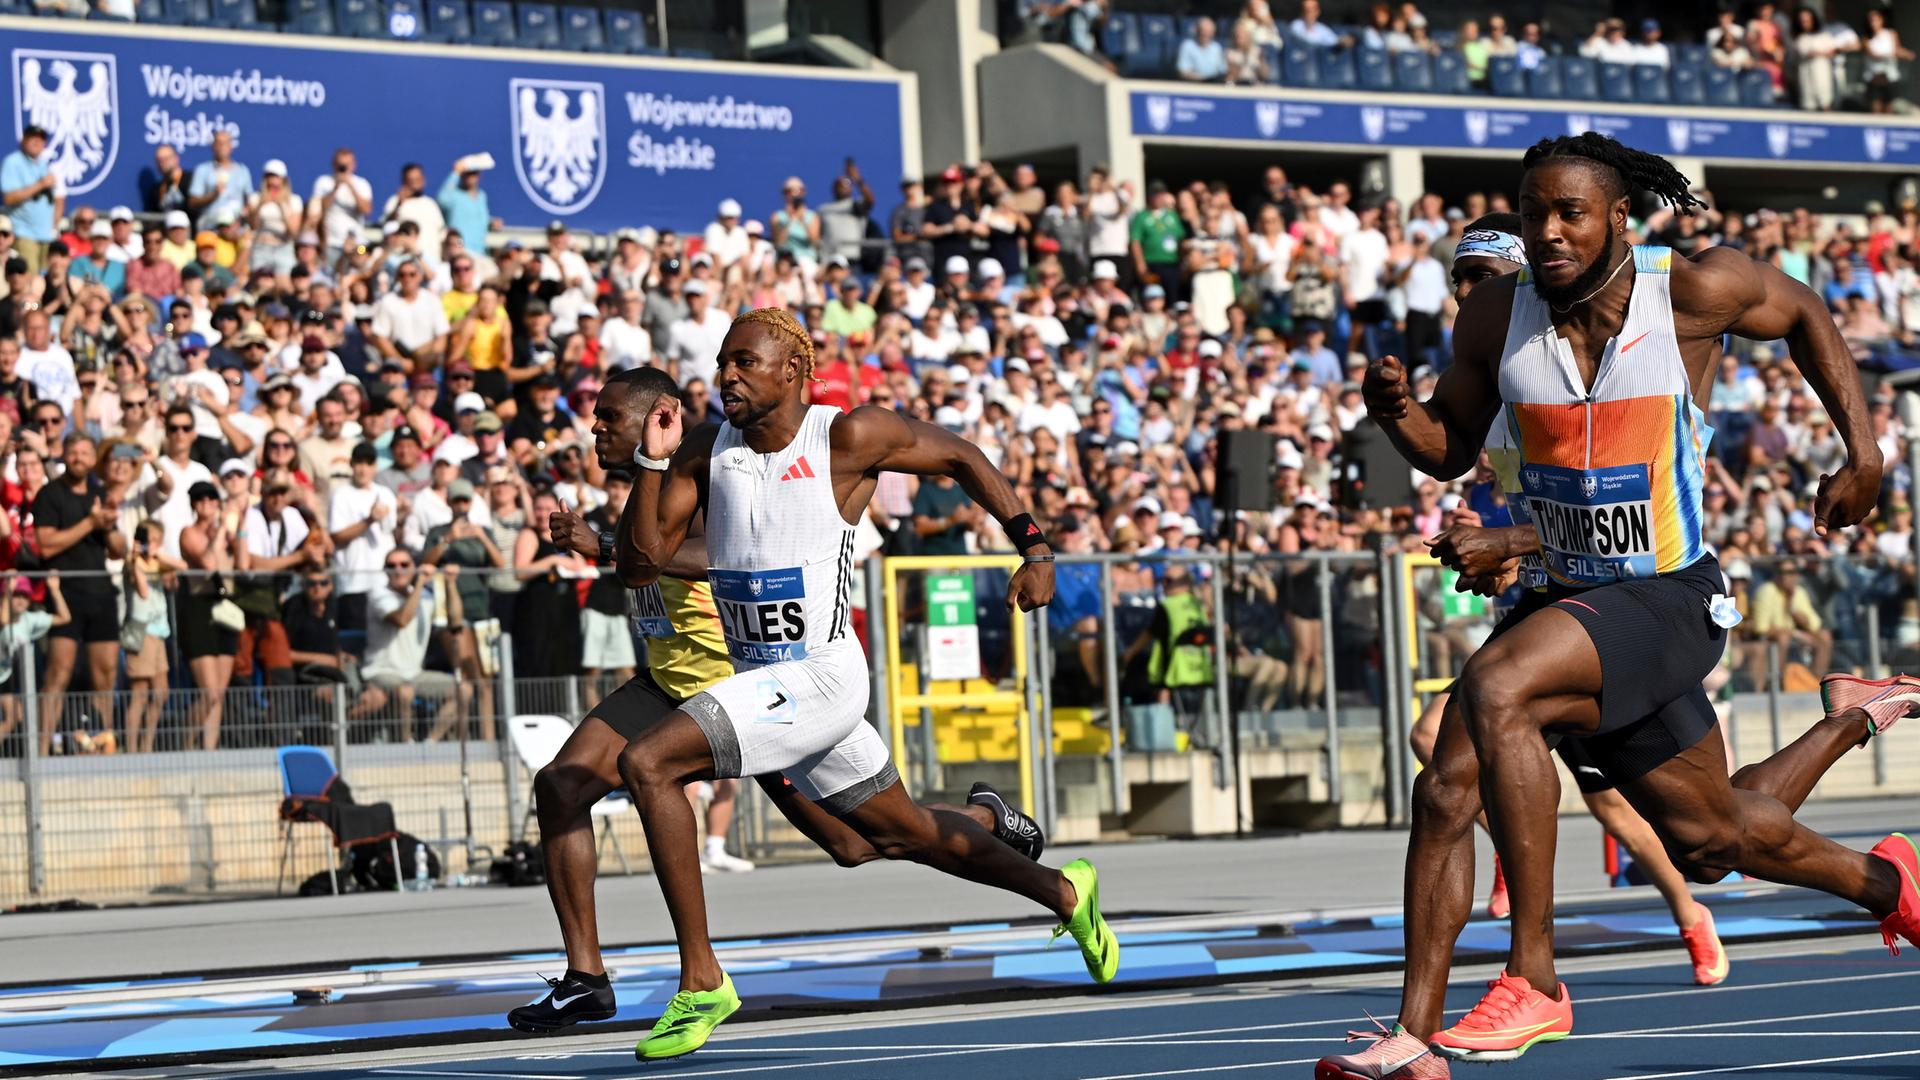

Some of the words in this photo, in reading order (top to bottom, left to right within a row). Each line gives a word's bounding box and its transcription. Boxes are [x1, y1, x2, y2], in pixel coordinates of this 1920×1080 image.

[141, 64, 326, 107] Województwo
[625, 91, 793, 132] Województwo
[628, 129, 716, 176] Śląskie
[1529, 499, 1650, 555] THOMPSON
[1567, 558, 1637, 577] SILESIA
[717, 600, 805, 642] LYLES
[742, 645, 794, 662] SILESIA
